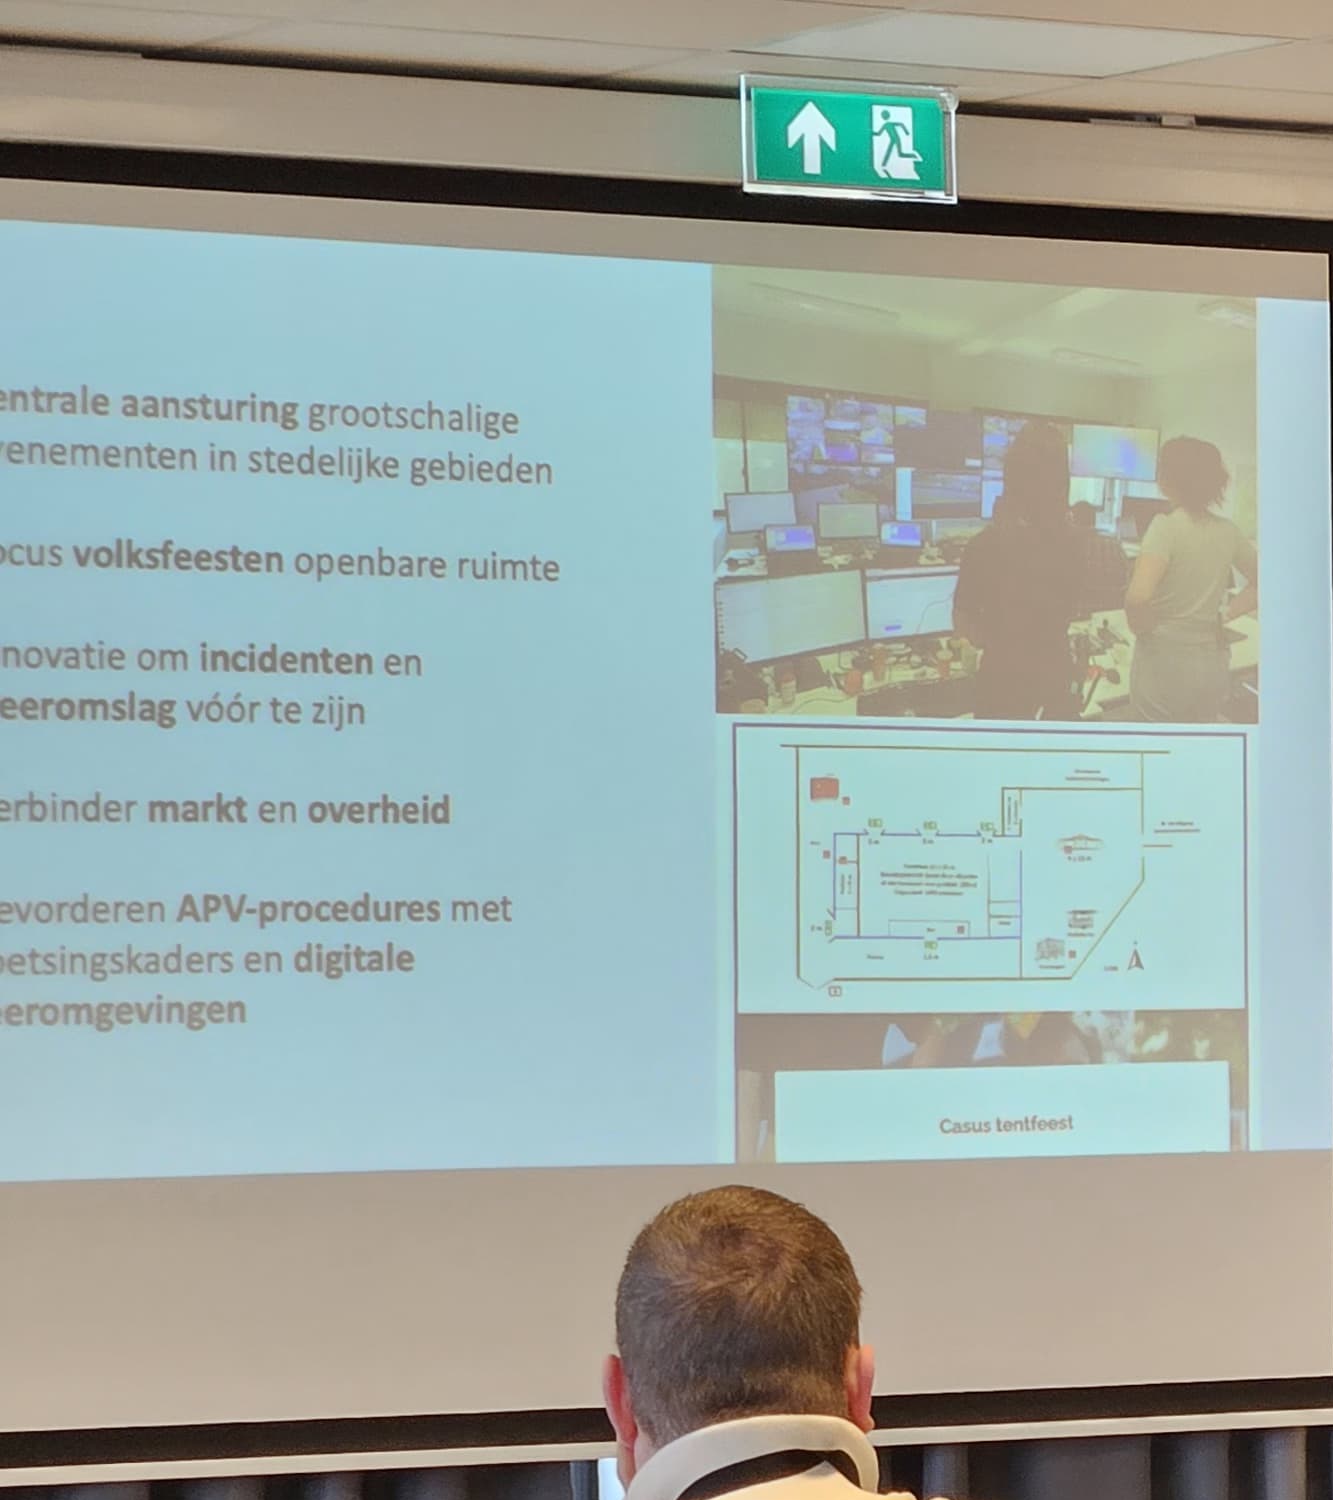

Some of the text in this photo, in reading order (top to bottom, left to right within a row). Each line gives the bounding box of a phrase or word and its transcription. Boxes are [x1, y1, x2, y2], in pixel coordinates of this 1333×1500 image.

[120, 391, 299, 430] aansturing
[307, 400, 520, 440] grootschalige
[0, 440, 553, 486] enementen in stedelijke gebieden
[72, 538, 284, 573] volksfeesten
[293, 546, 448, 580] openbare
[457, 552, 560, 582] ruimte
[2, 640, 422, 676] novatie om incidenten en
[0, 691, 366, 731] eeromslag vóór te zijn
[0, 792, 451, 825] erbinder markt en overheid
[0, 892, 512, 928] evorderen APV-procedures met
[0, 942, 415, 982] etsingskaders en digitale
[0, 994, 247, 1032] eromgevingen
[939, 1114, 1074, 1136] Casus tentfeest
